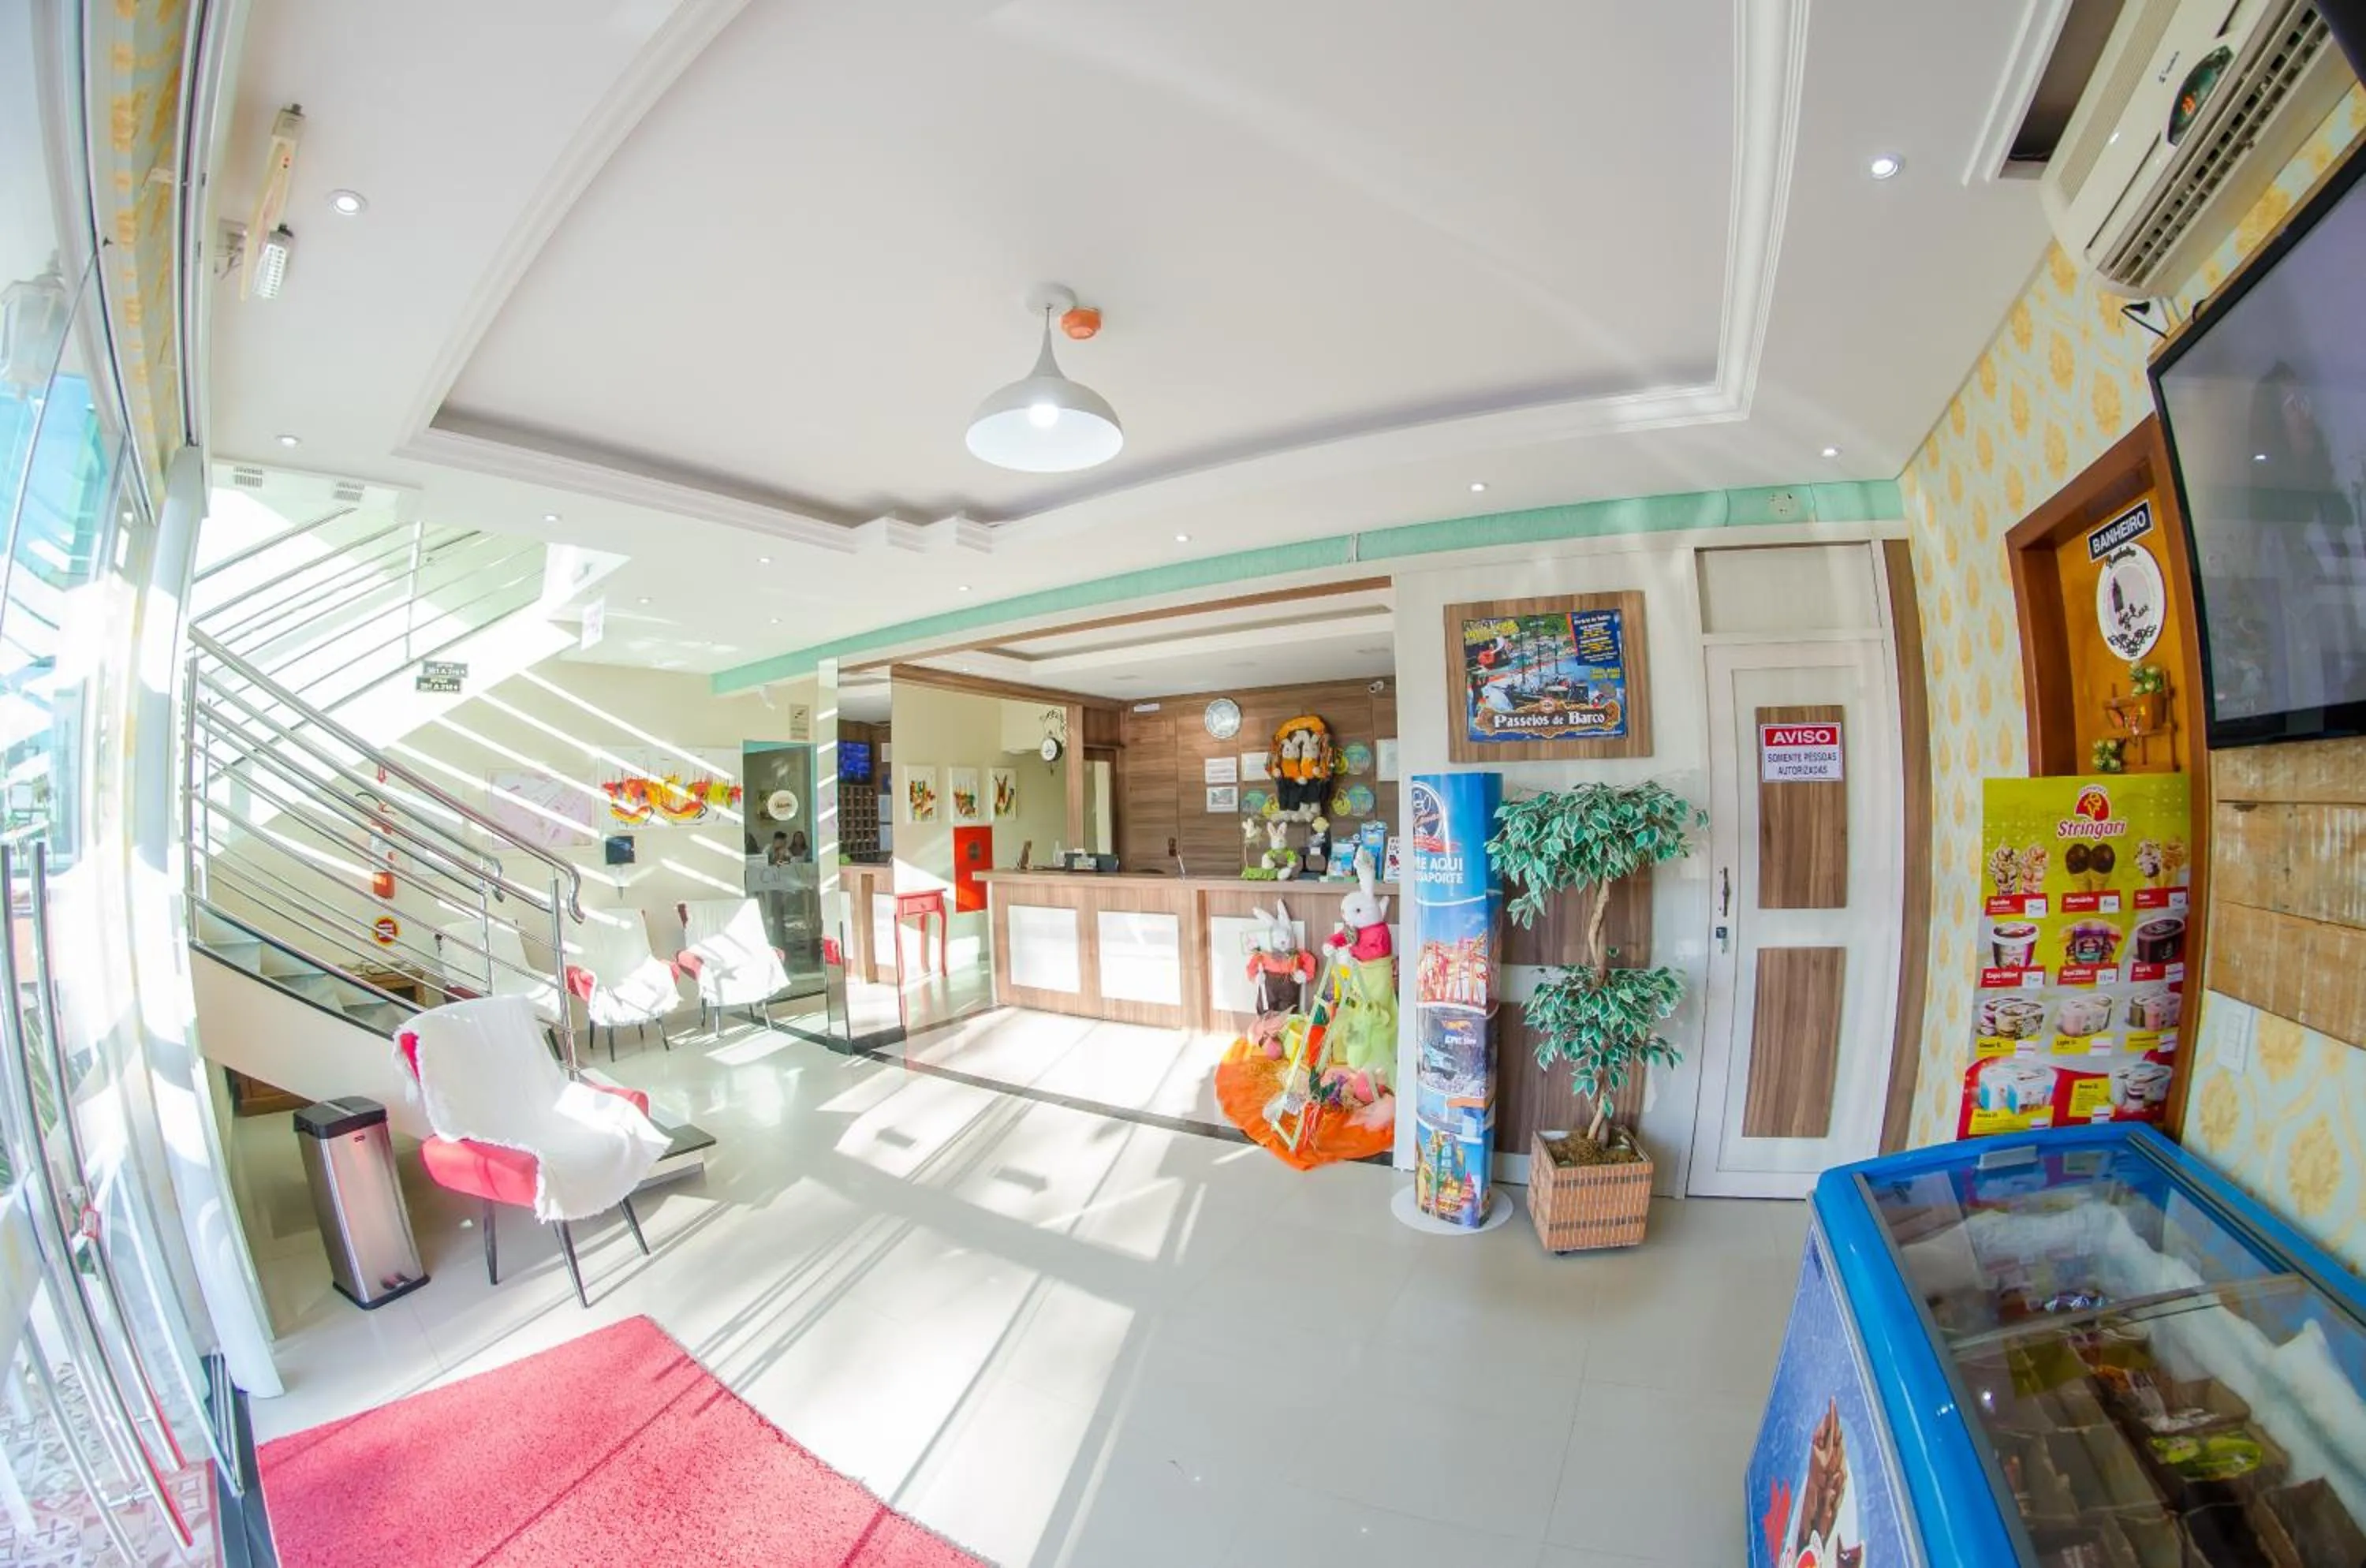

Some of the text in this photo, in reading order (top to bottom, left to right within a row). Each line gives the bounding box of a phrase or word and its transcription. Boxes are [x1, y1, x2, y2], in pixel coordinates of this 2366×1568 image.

[2091, 510, 2148, 554] BANHEIRO
[1494, 710, 1605, 728] Passeios de Barco
[1772, 730, 1830, 744] AVISO
[1767, 752, 1837, 763] SOMENTE PESSOAS
[1778, 765, 1828, 775] AUTORIZADAS
[2058, 819, 2126, 840] Stringari
[1430, 857, 1463, 871] AQUI
